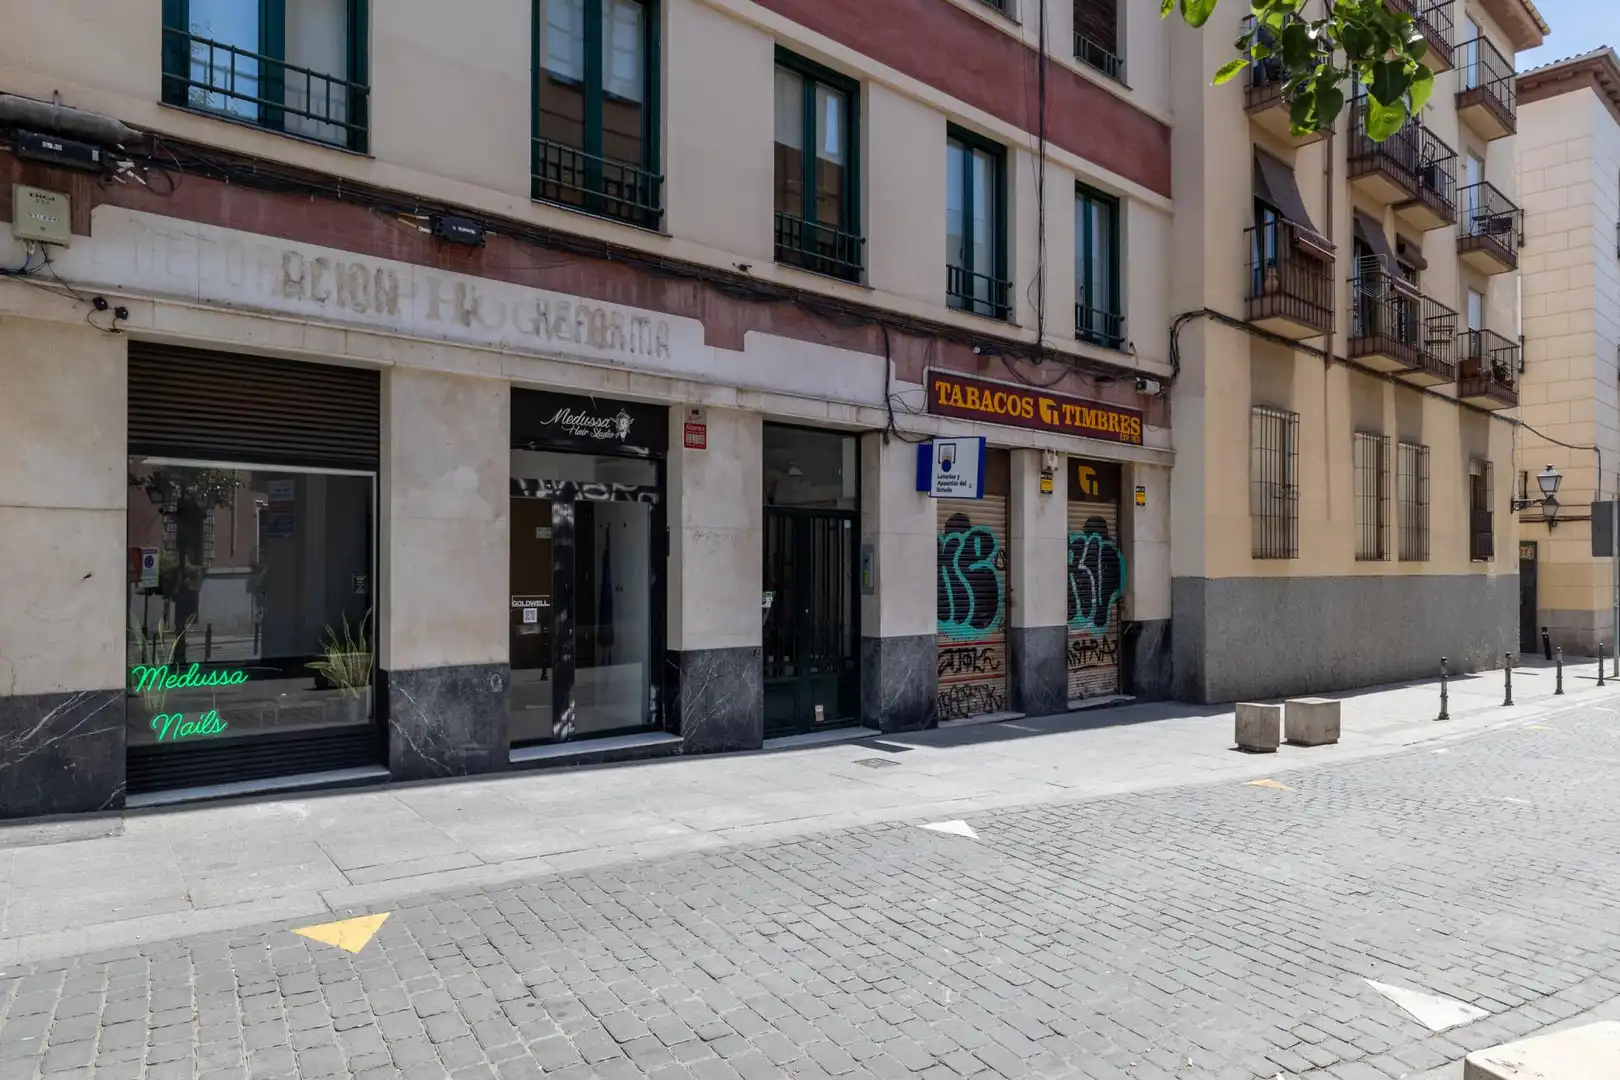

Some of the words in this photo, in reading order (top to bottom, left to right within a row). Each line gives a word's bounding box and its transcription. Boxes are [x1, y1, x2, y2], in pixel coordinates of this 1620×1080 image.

[540, 407, 611, 428] Medussa
[935, 380, 1034, 419] TABACOS
[1062, 404, 1141, 436] TIMBRES
[561, 425, 589, 436] Hair
[590, 427, 614, 439] Studio
[132, 662, 249, 693] Medussa
[151, 708, 229, 741] Nails
